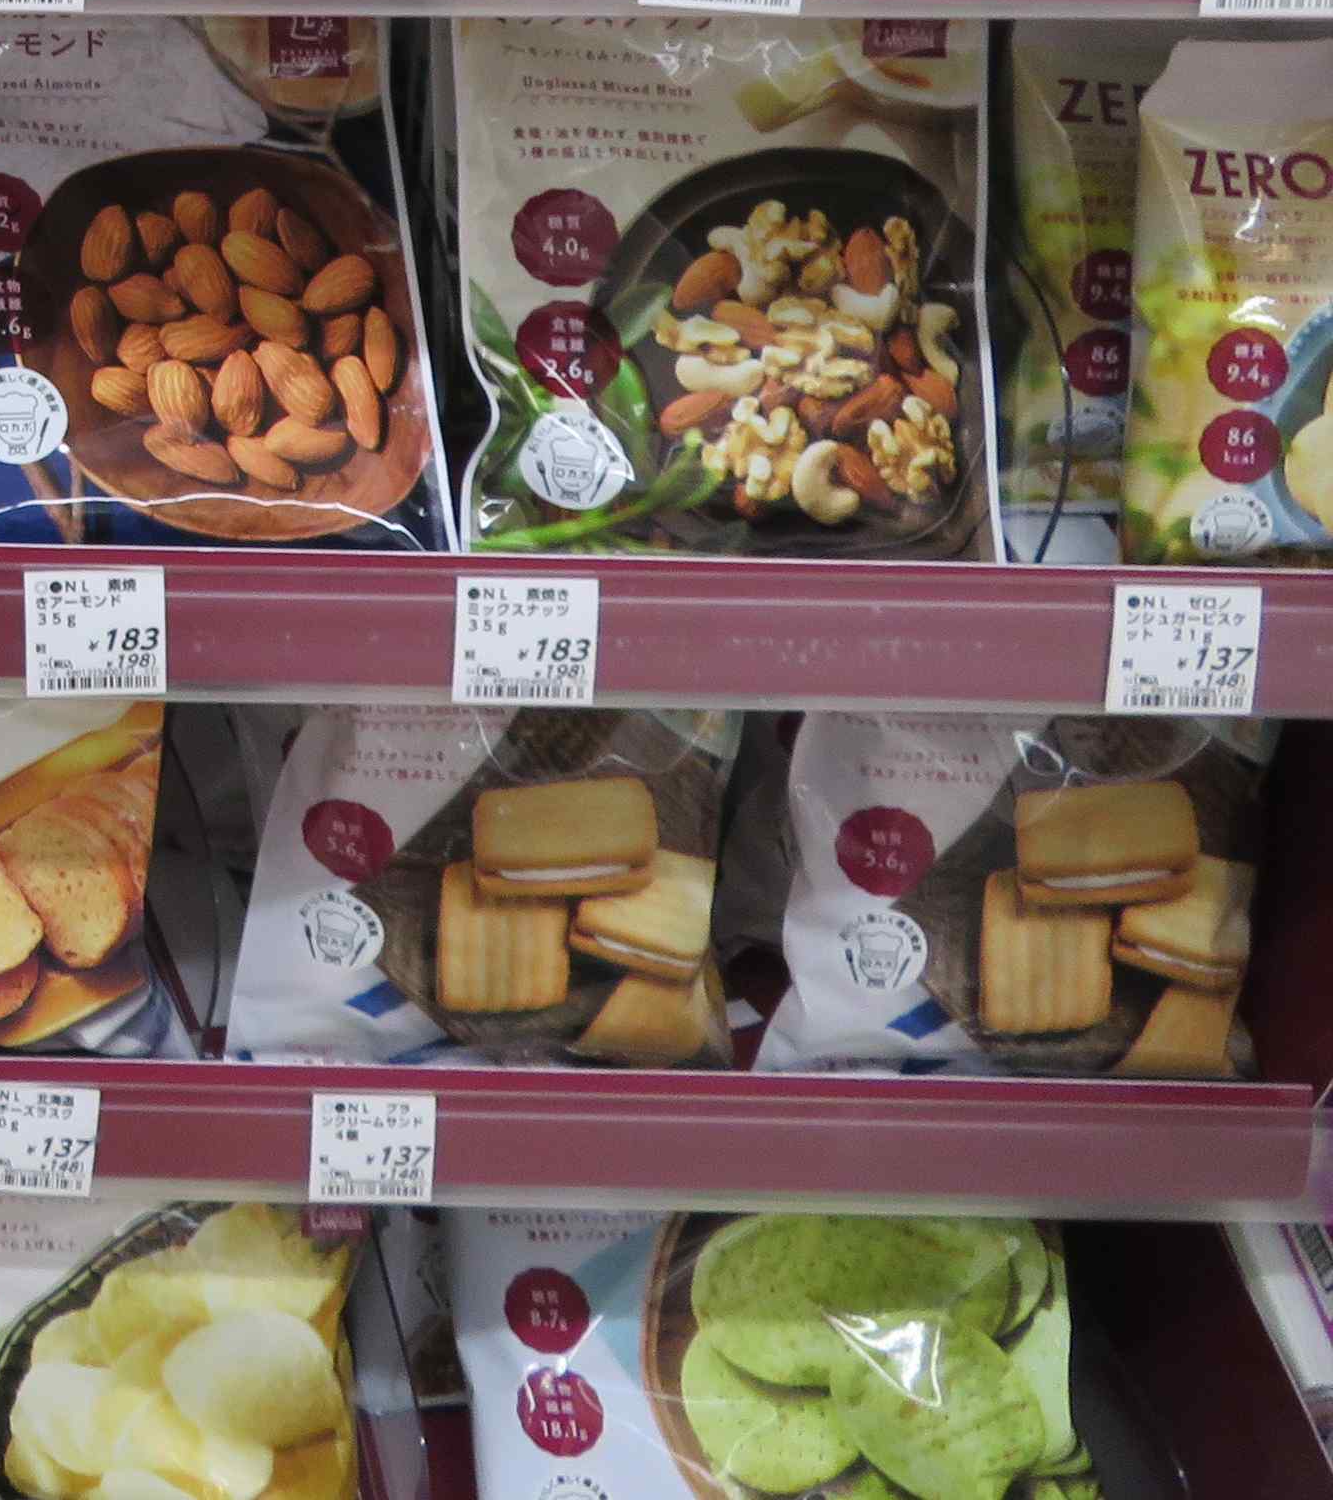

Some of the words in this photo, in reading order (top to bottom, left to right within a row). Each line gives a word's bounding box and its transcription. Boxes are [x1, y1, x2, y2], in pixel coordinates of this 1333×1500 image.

[1184, 148, 1333, 200] ZERO
[541, 238, 590, 261] 4.0g
[1226, 363, 1270, 388] 9.4g
[1227, 428, 1256, 447] 86
[36, 595, 122, 609] きアーモンド
[468, 603, 569, 617] ミックスナッツ
[37, 612, 76, 628] 35g
[468, 619, 508, 636] 35g
[1126, 612, 1246, 626] ンシュガービスケ
[864, 849, 908, 873] 5.6g
